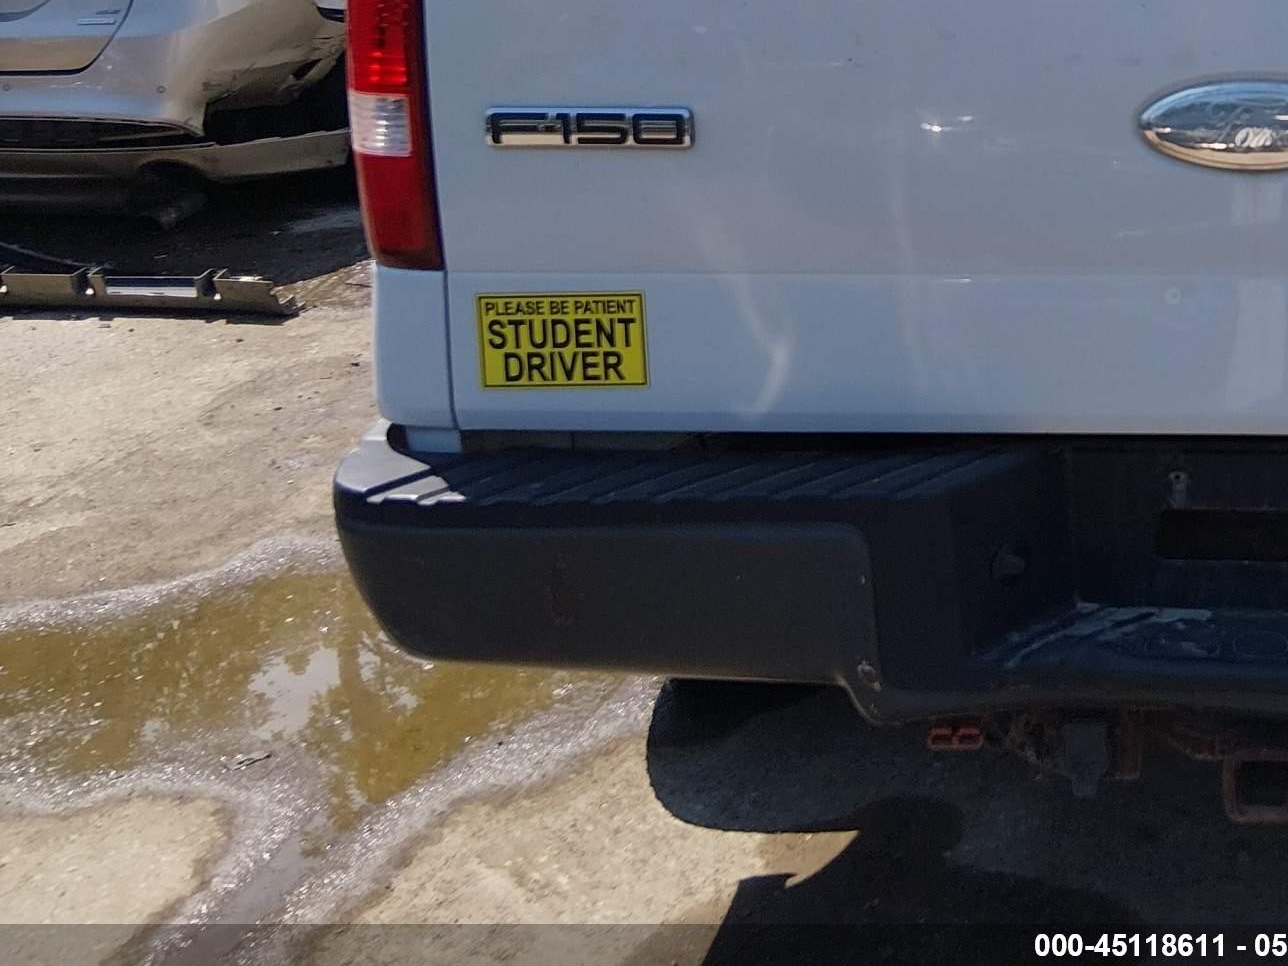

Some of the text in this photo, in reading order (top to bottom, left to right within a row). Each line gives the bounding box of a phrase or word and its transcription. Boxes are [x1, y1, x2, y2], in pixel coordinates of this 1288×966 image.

[485, 298, 637, 316] PLEASE BE PATIENT
[488, 317, 637, 350] STUDENT
[504, 350, 625, 382] DRIVER
